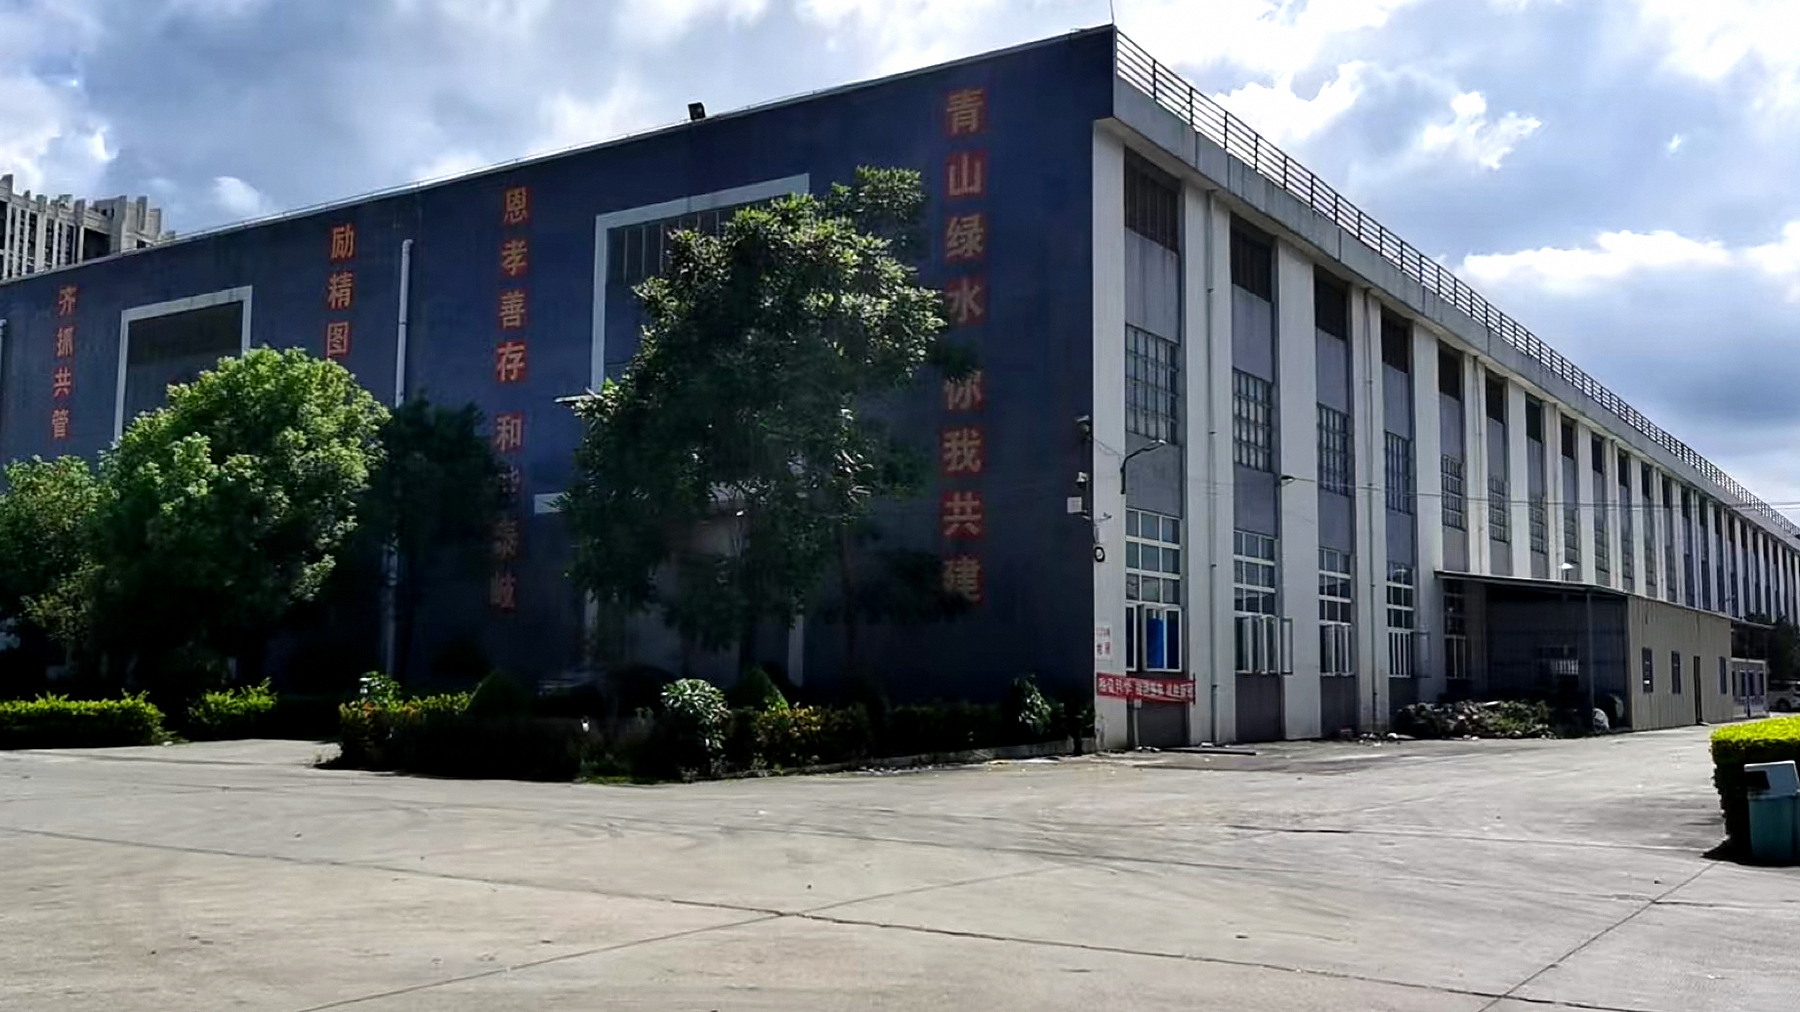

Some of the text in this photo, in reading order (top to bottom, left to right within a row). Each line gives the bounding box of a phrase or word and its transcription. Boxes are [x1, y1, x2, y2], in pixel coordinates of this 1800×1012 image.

[326, 223, 356, 356] 励精图
[497, 186, 529, 382] 恩孝善存
[946, 88, 985, 324] 青山绿水
[51, 285, 78, 439] 齐抓共管
